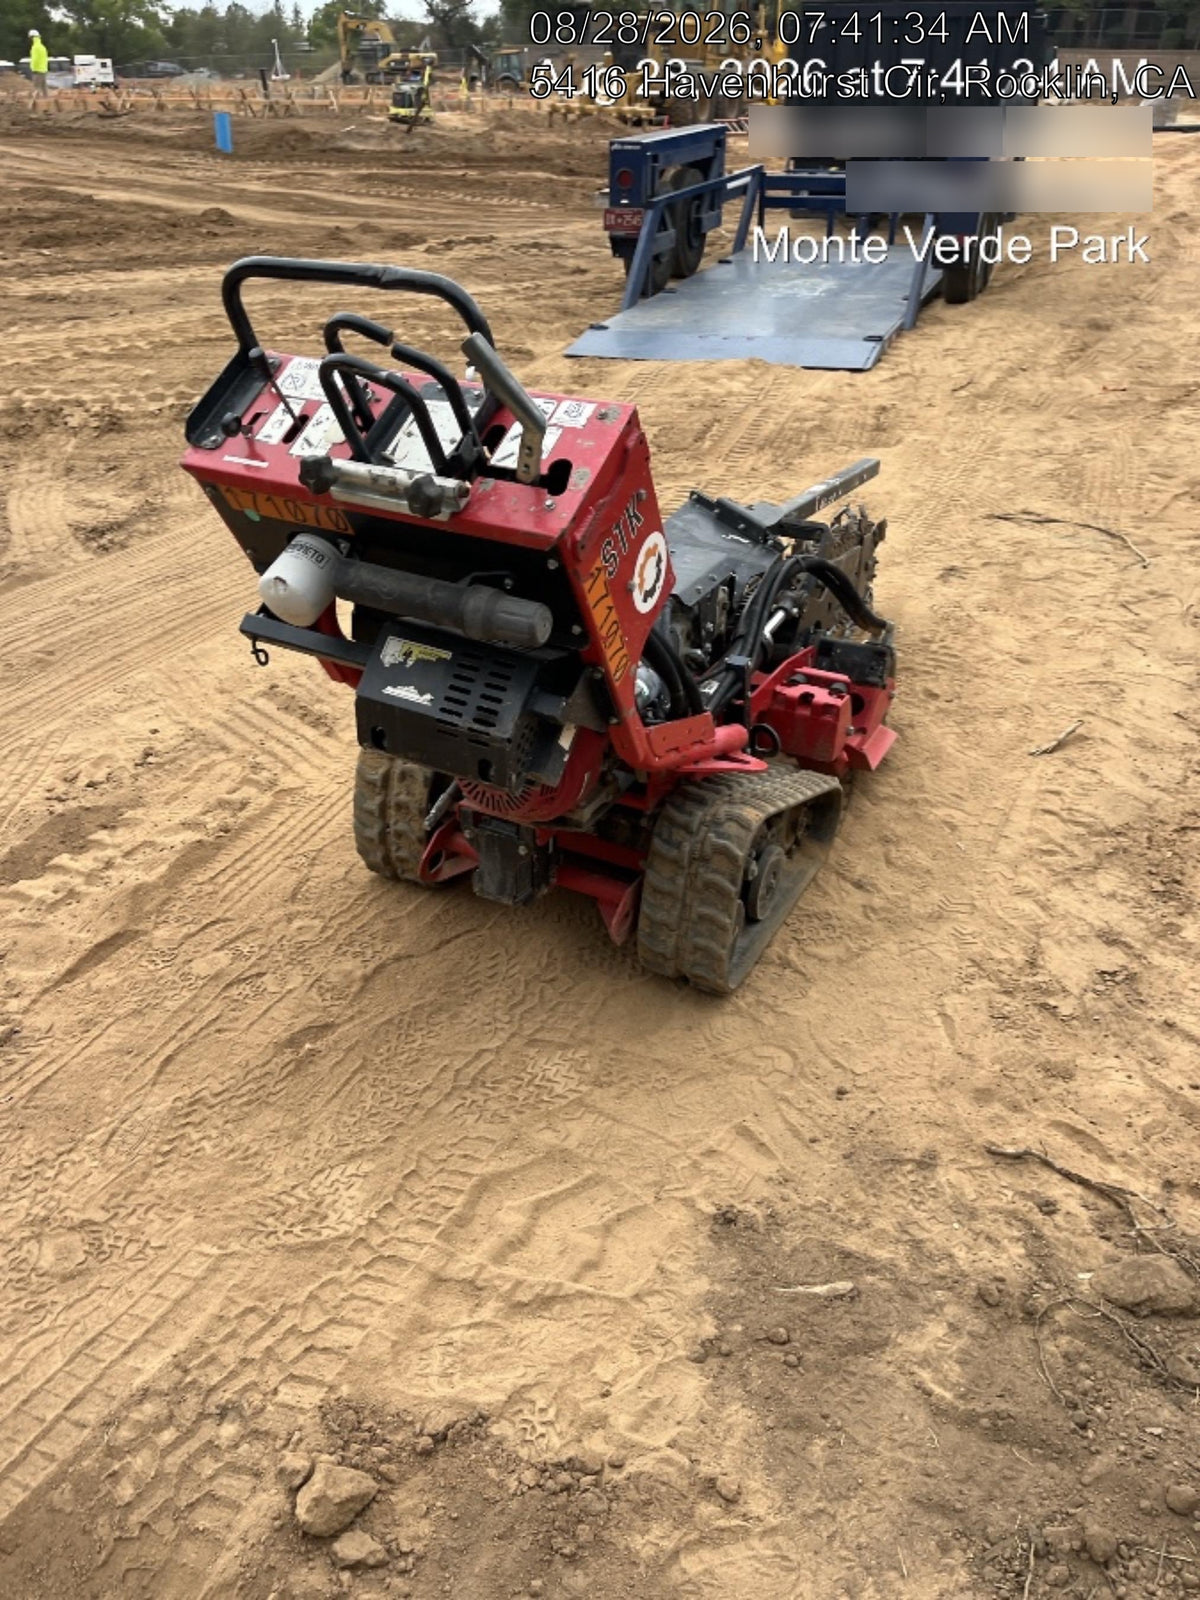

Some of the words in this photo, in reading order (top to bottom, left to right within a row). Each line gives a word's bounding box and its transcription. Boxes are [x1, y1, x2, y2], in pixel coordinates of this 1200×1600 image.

[224, 485, 350, 532] 171070
[600, 492, 645, 579] STK
[586, 566, 632, 683] 171070
